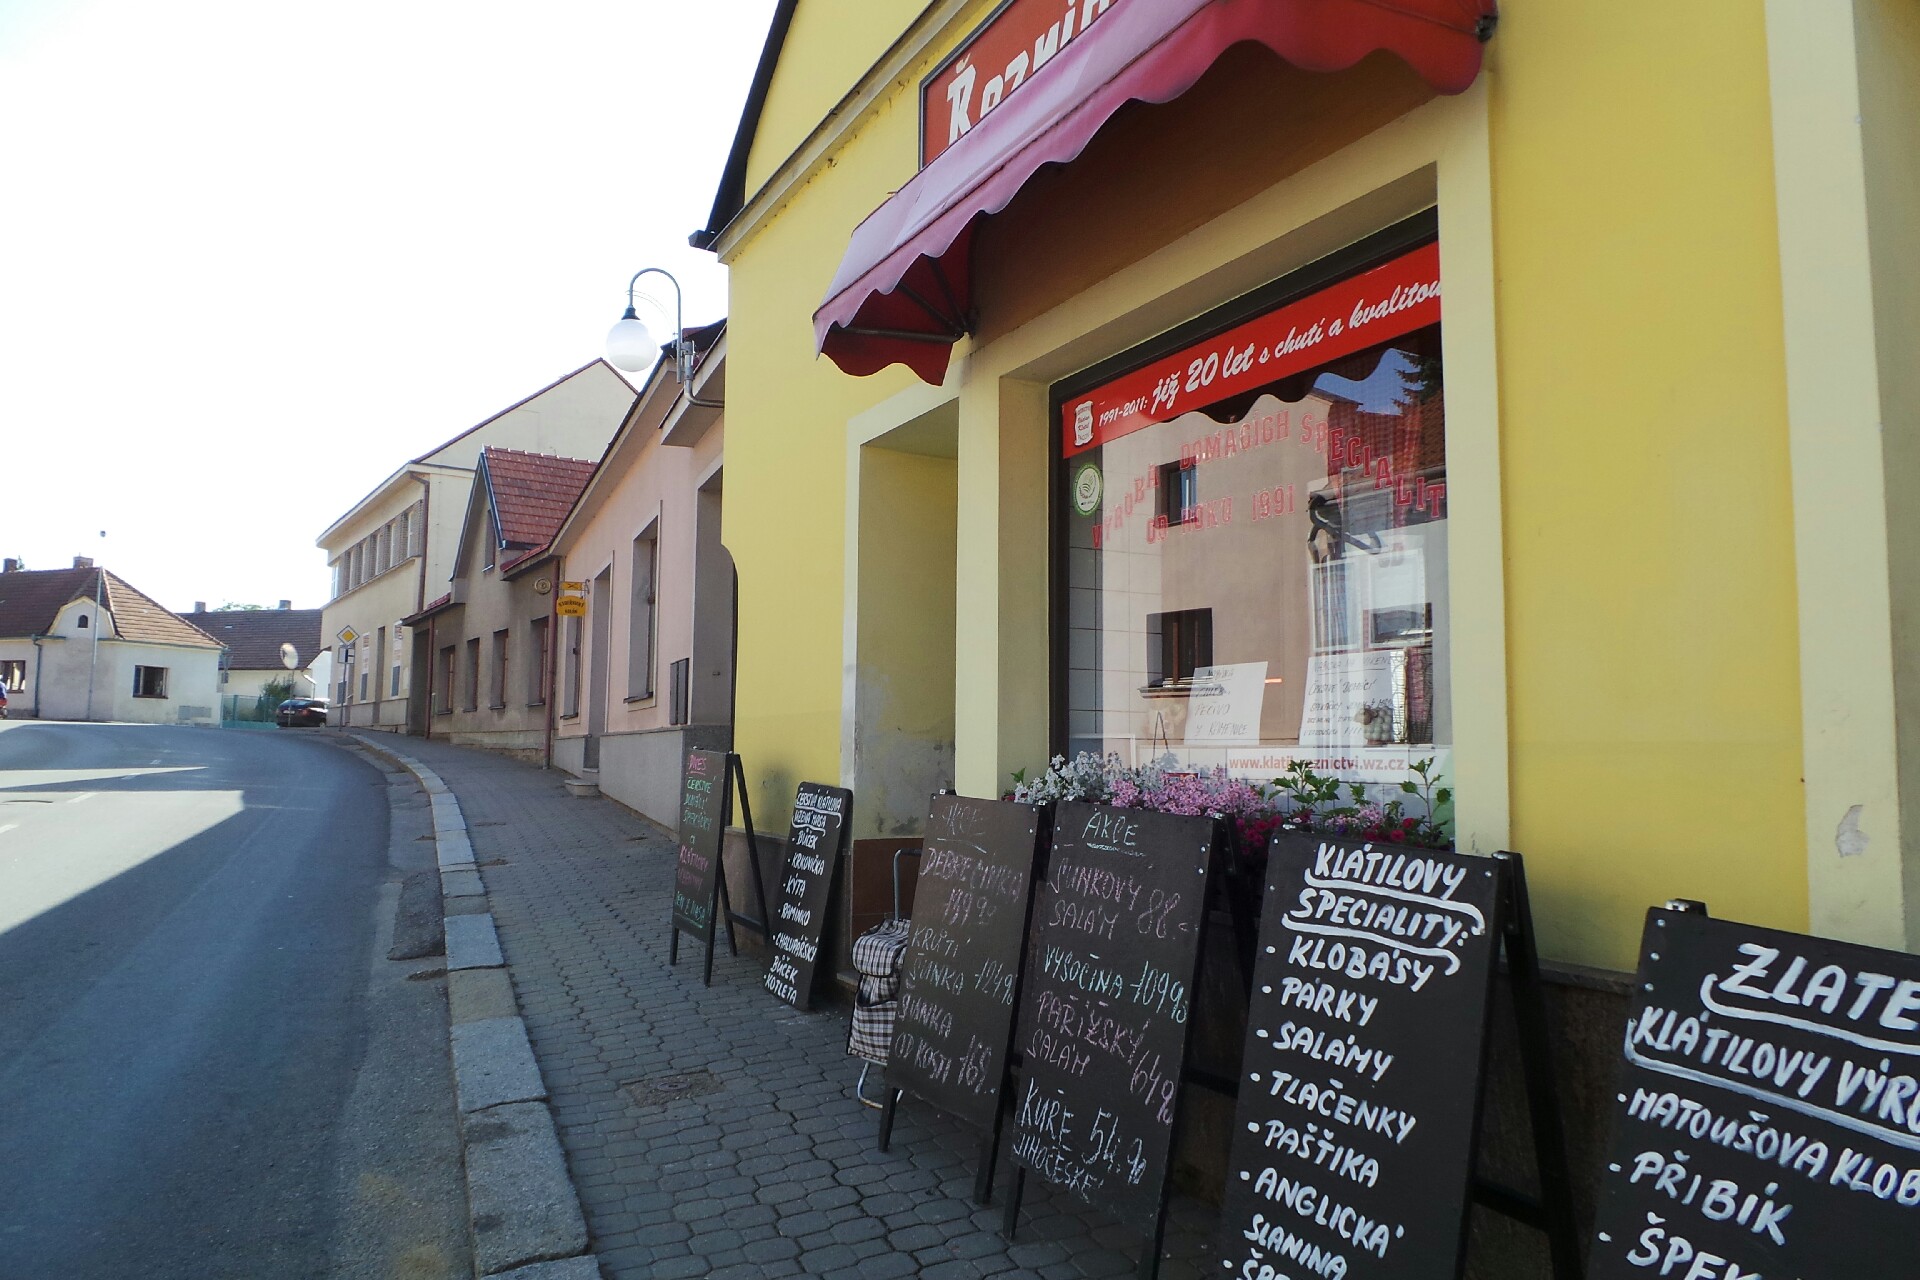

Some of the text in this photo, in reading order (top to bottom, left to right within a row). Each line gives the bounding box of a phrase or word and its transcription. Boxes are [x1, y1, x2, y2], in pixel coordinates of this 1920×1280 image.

[1150, 371, 1181, 415] již
[1185, 352, 1218, 393] 20
[1222, 342, 1255, 379] let
[1258, 346, 1271, 364] s
[1274, 317, 1326, 358] chutí
[1328, 318, 1345, 337] a
[1349, 279, 1441, 329] kvalitou
[1251, 483, 1295, 522] 1991
[1081, 811, 1139, 846] AKCE
[785, 872, 806, 898] KÝTA
[1314, 842, 1467, 900] KLÁTILOVY
[1048, 899, 1119, 940] SALÁM
[764, 972, 797, 1005] KOTLETA
[770, 954, 798, 985] BŮČEK
[1044, 944, 1124, 999] VYSOČINA
[1287, 935, 1434, 992] KLOBÁSY
[1280, 976, 1378, 1027] PÁRKY
[1026, 1029, 1091, 1078] SALÁM
[1272, 1019, 1395, 1082] SALÁMY
[1631, 1005, 1832, 1099] KLÁTILOVY
[1021, 1077, 1075, 1146] KUŘE
[1270, 1077, 1417, 1144] TLAČENKY
[1627, 1087, 1830, 1179] MATOUŠOVA
[1253, 1166, 1405, 1259] ANGLICKÁ
[1242, 1212, 1349, 1280] SLANINA
